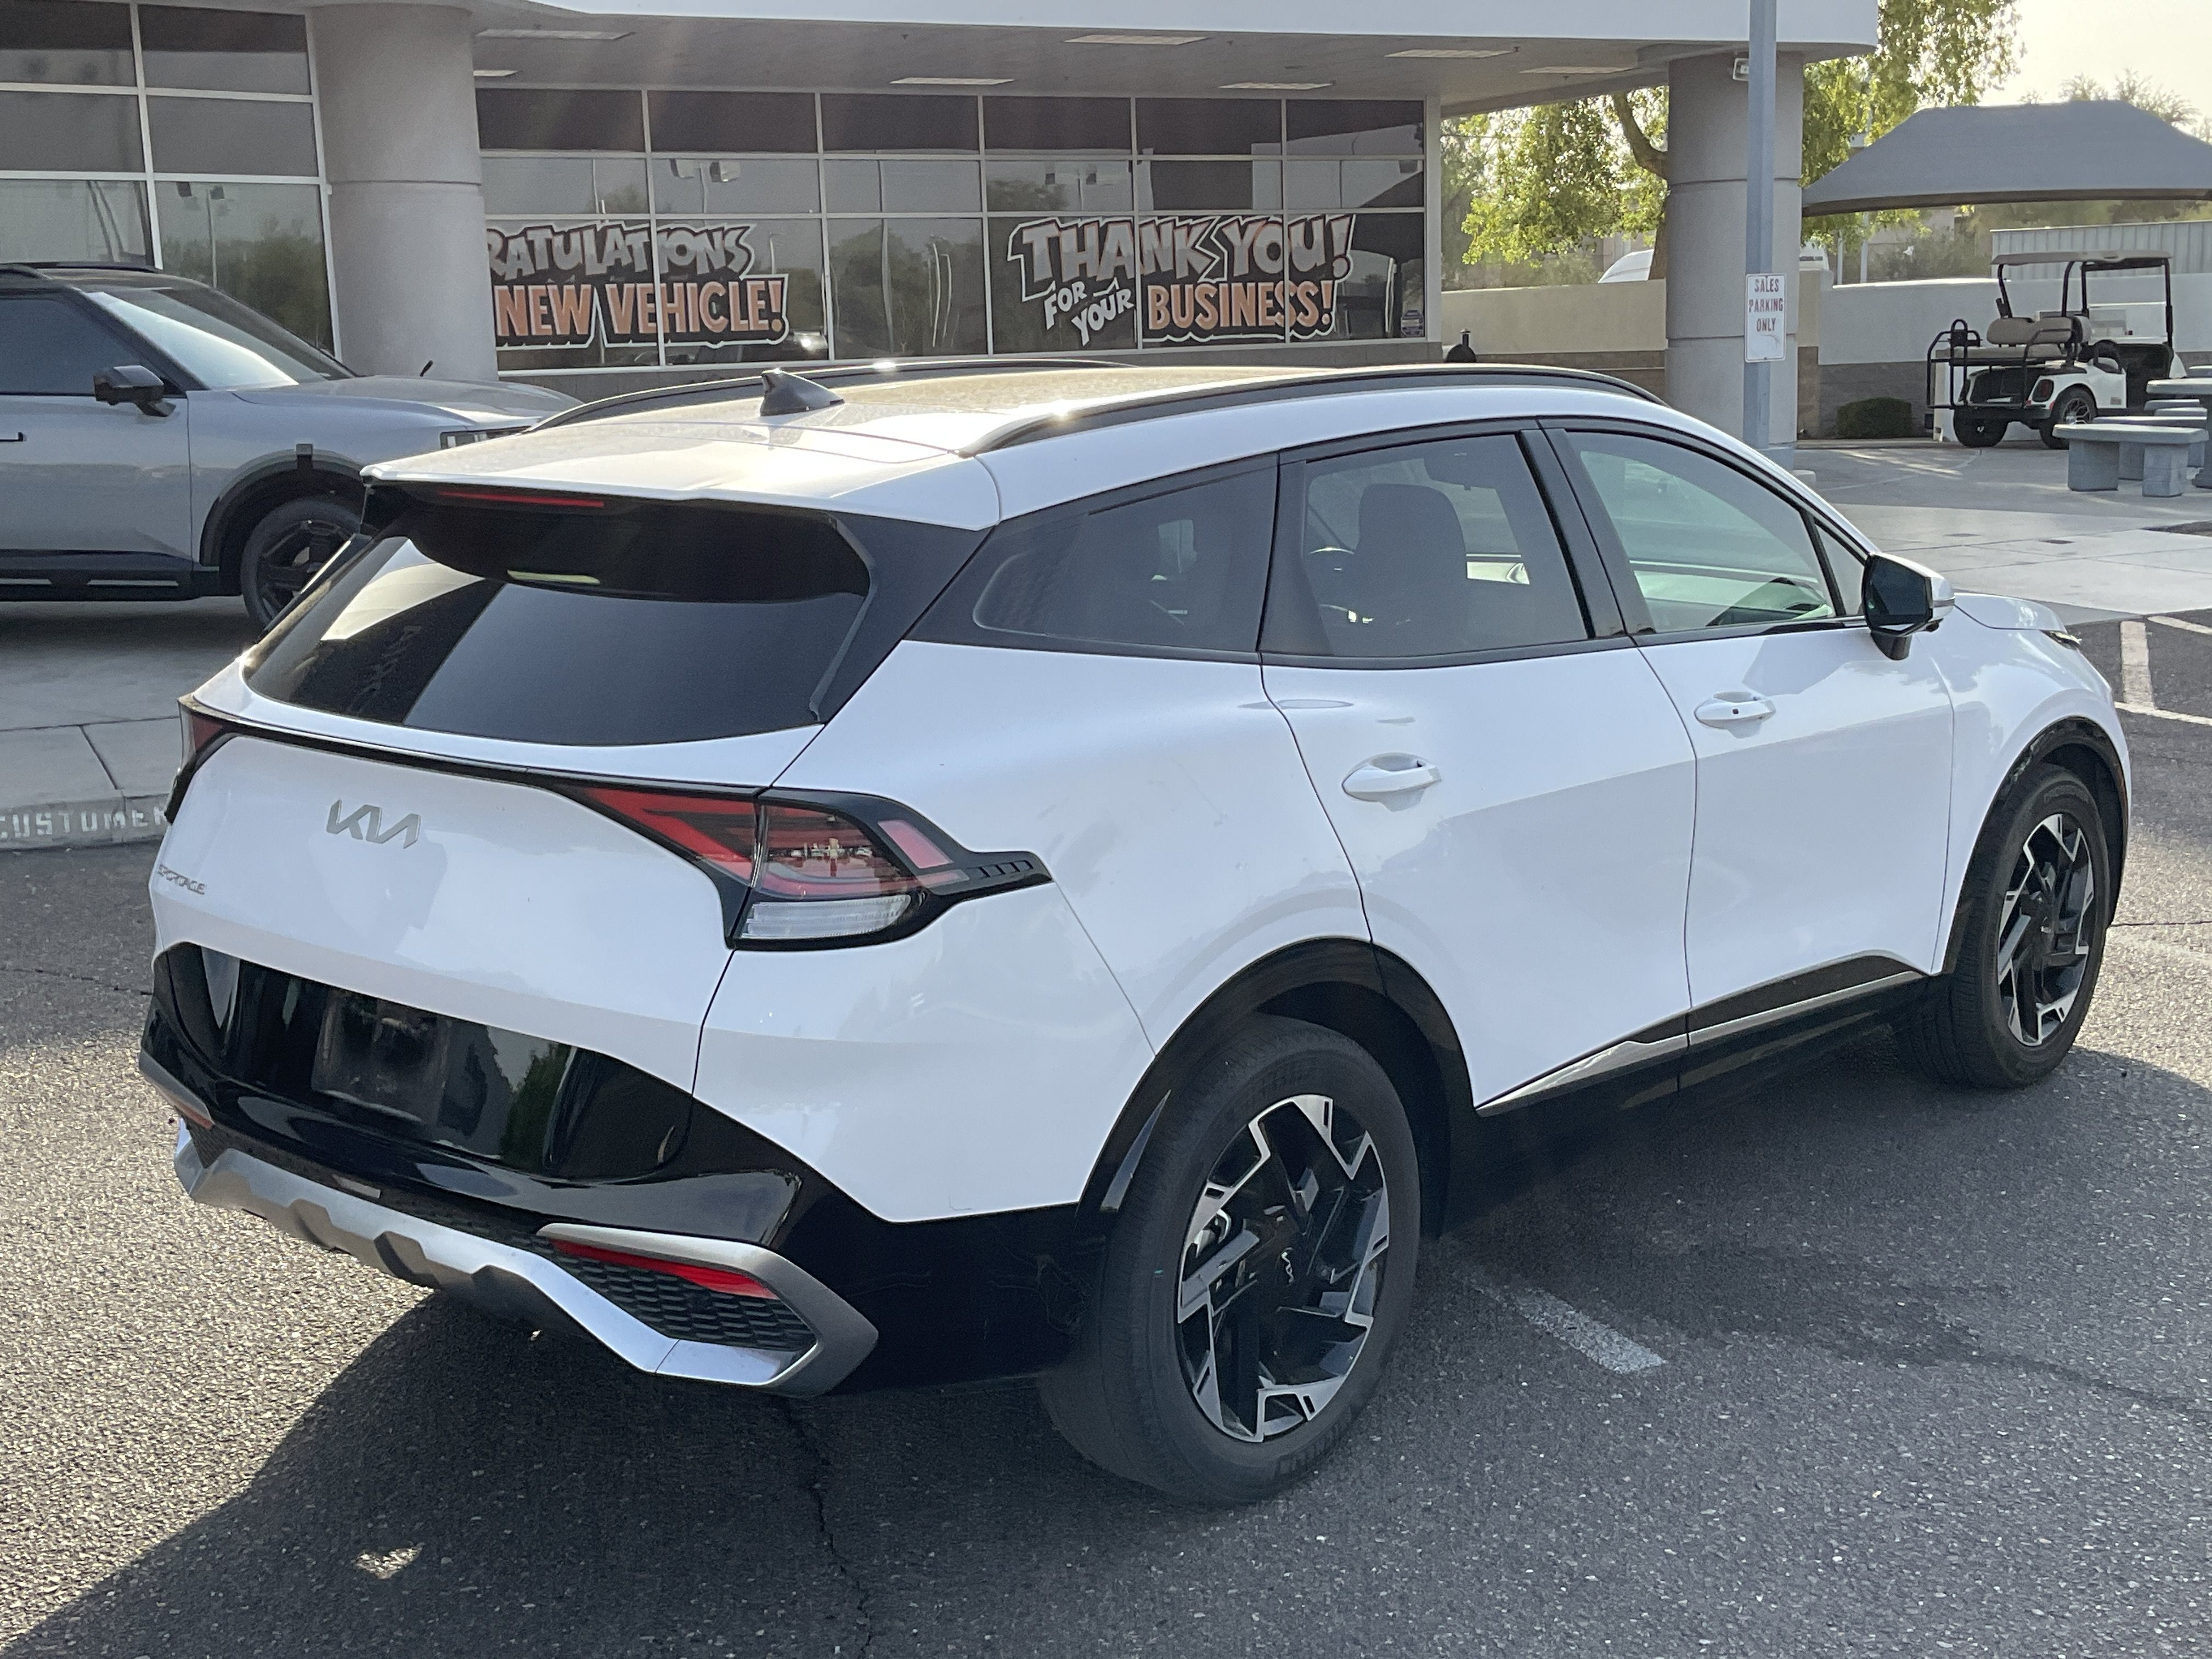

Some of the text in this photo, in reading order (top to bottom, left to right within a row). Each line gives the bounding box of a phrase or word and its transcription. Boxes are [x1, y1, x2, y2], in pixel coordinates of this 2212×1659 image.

[1022, 217, 1351, 283] THANK YOU!
[494, 280, 783, 336] NEW VEHICLE!
[1044, 281, 1087, 330] FOR
[1147, 280, 1334, 330] BUSINESS!
[1748, 297, 1784, 313] PARKING
[1754, 279, 1779, 292] SALES
[1071, 289, 1135, 347] YOUR
[1757, 317, 1776, 332] ONLY
